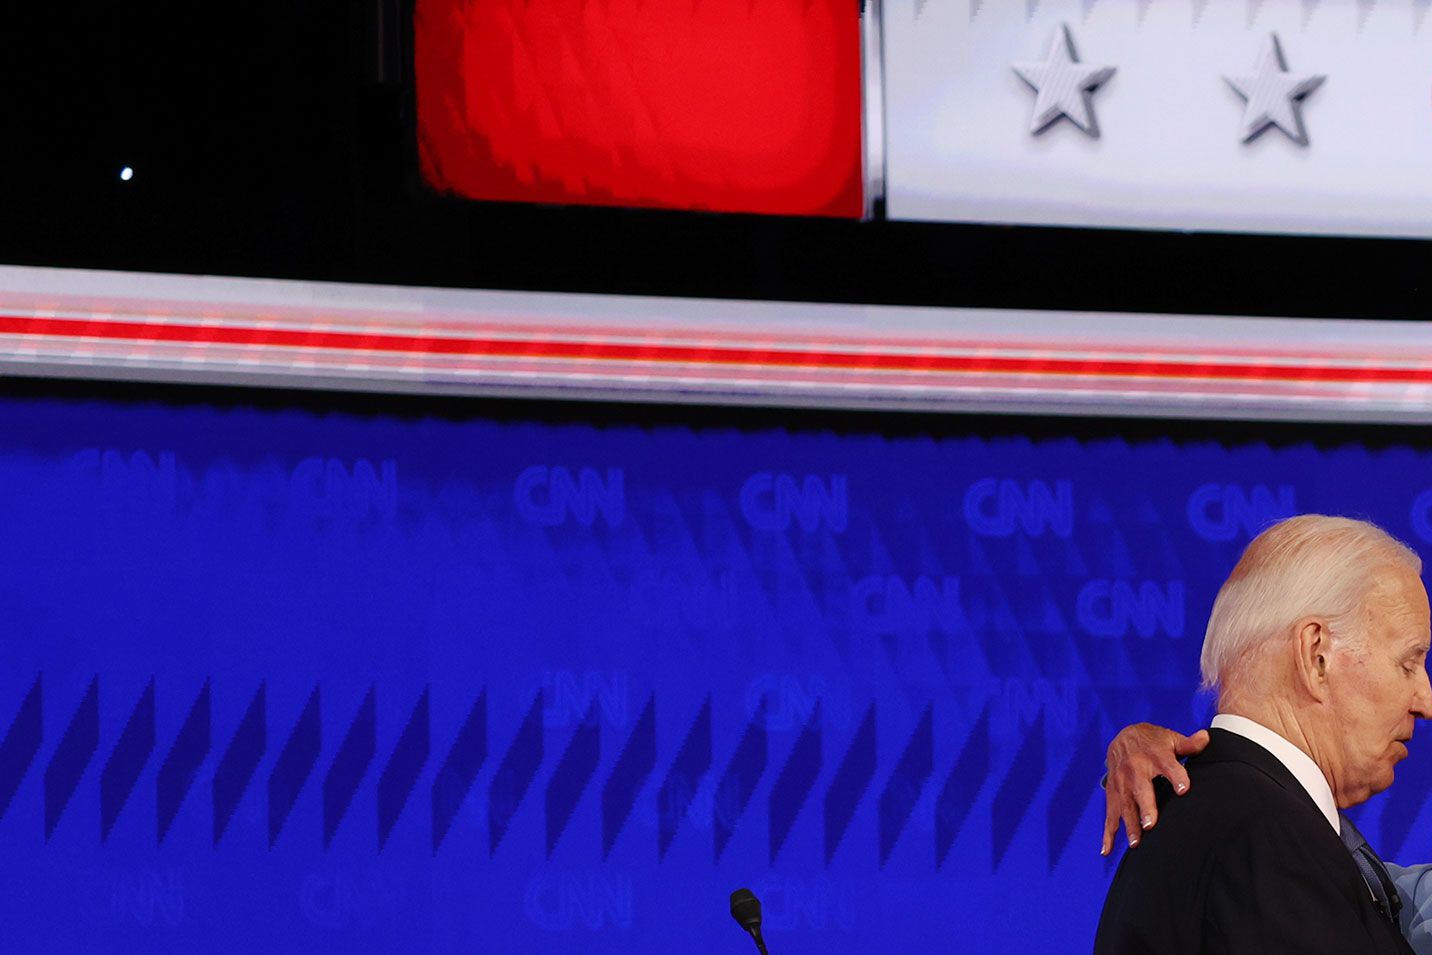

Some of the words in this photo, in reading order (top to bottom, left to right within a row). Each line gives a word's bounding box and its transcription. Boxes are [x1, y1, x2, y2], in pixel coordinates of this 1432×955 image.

[513, 464, 626, 527] CNN
[739, 471, 849, 534] CNN
[962, 477, 1075, 538] CNN
[1076, 578, 1186, 639] CNN
